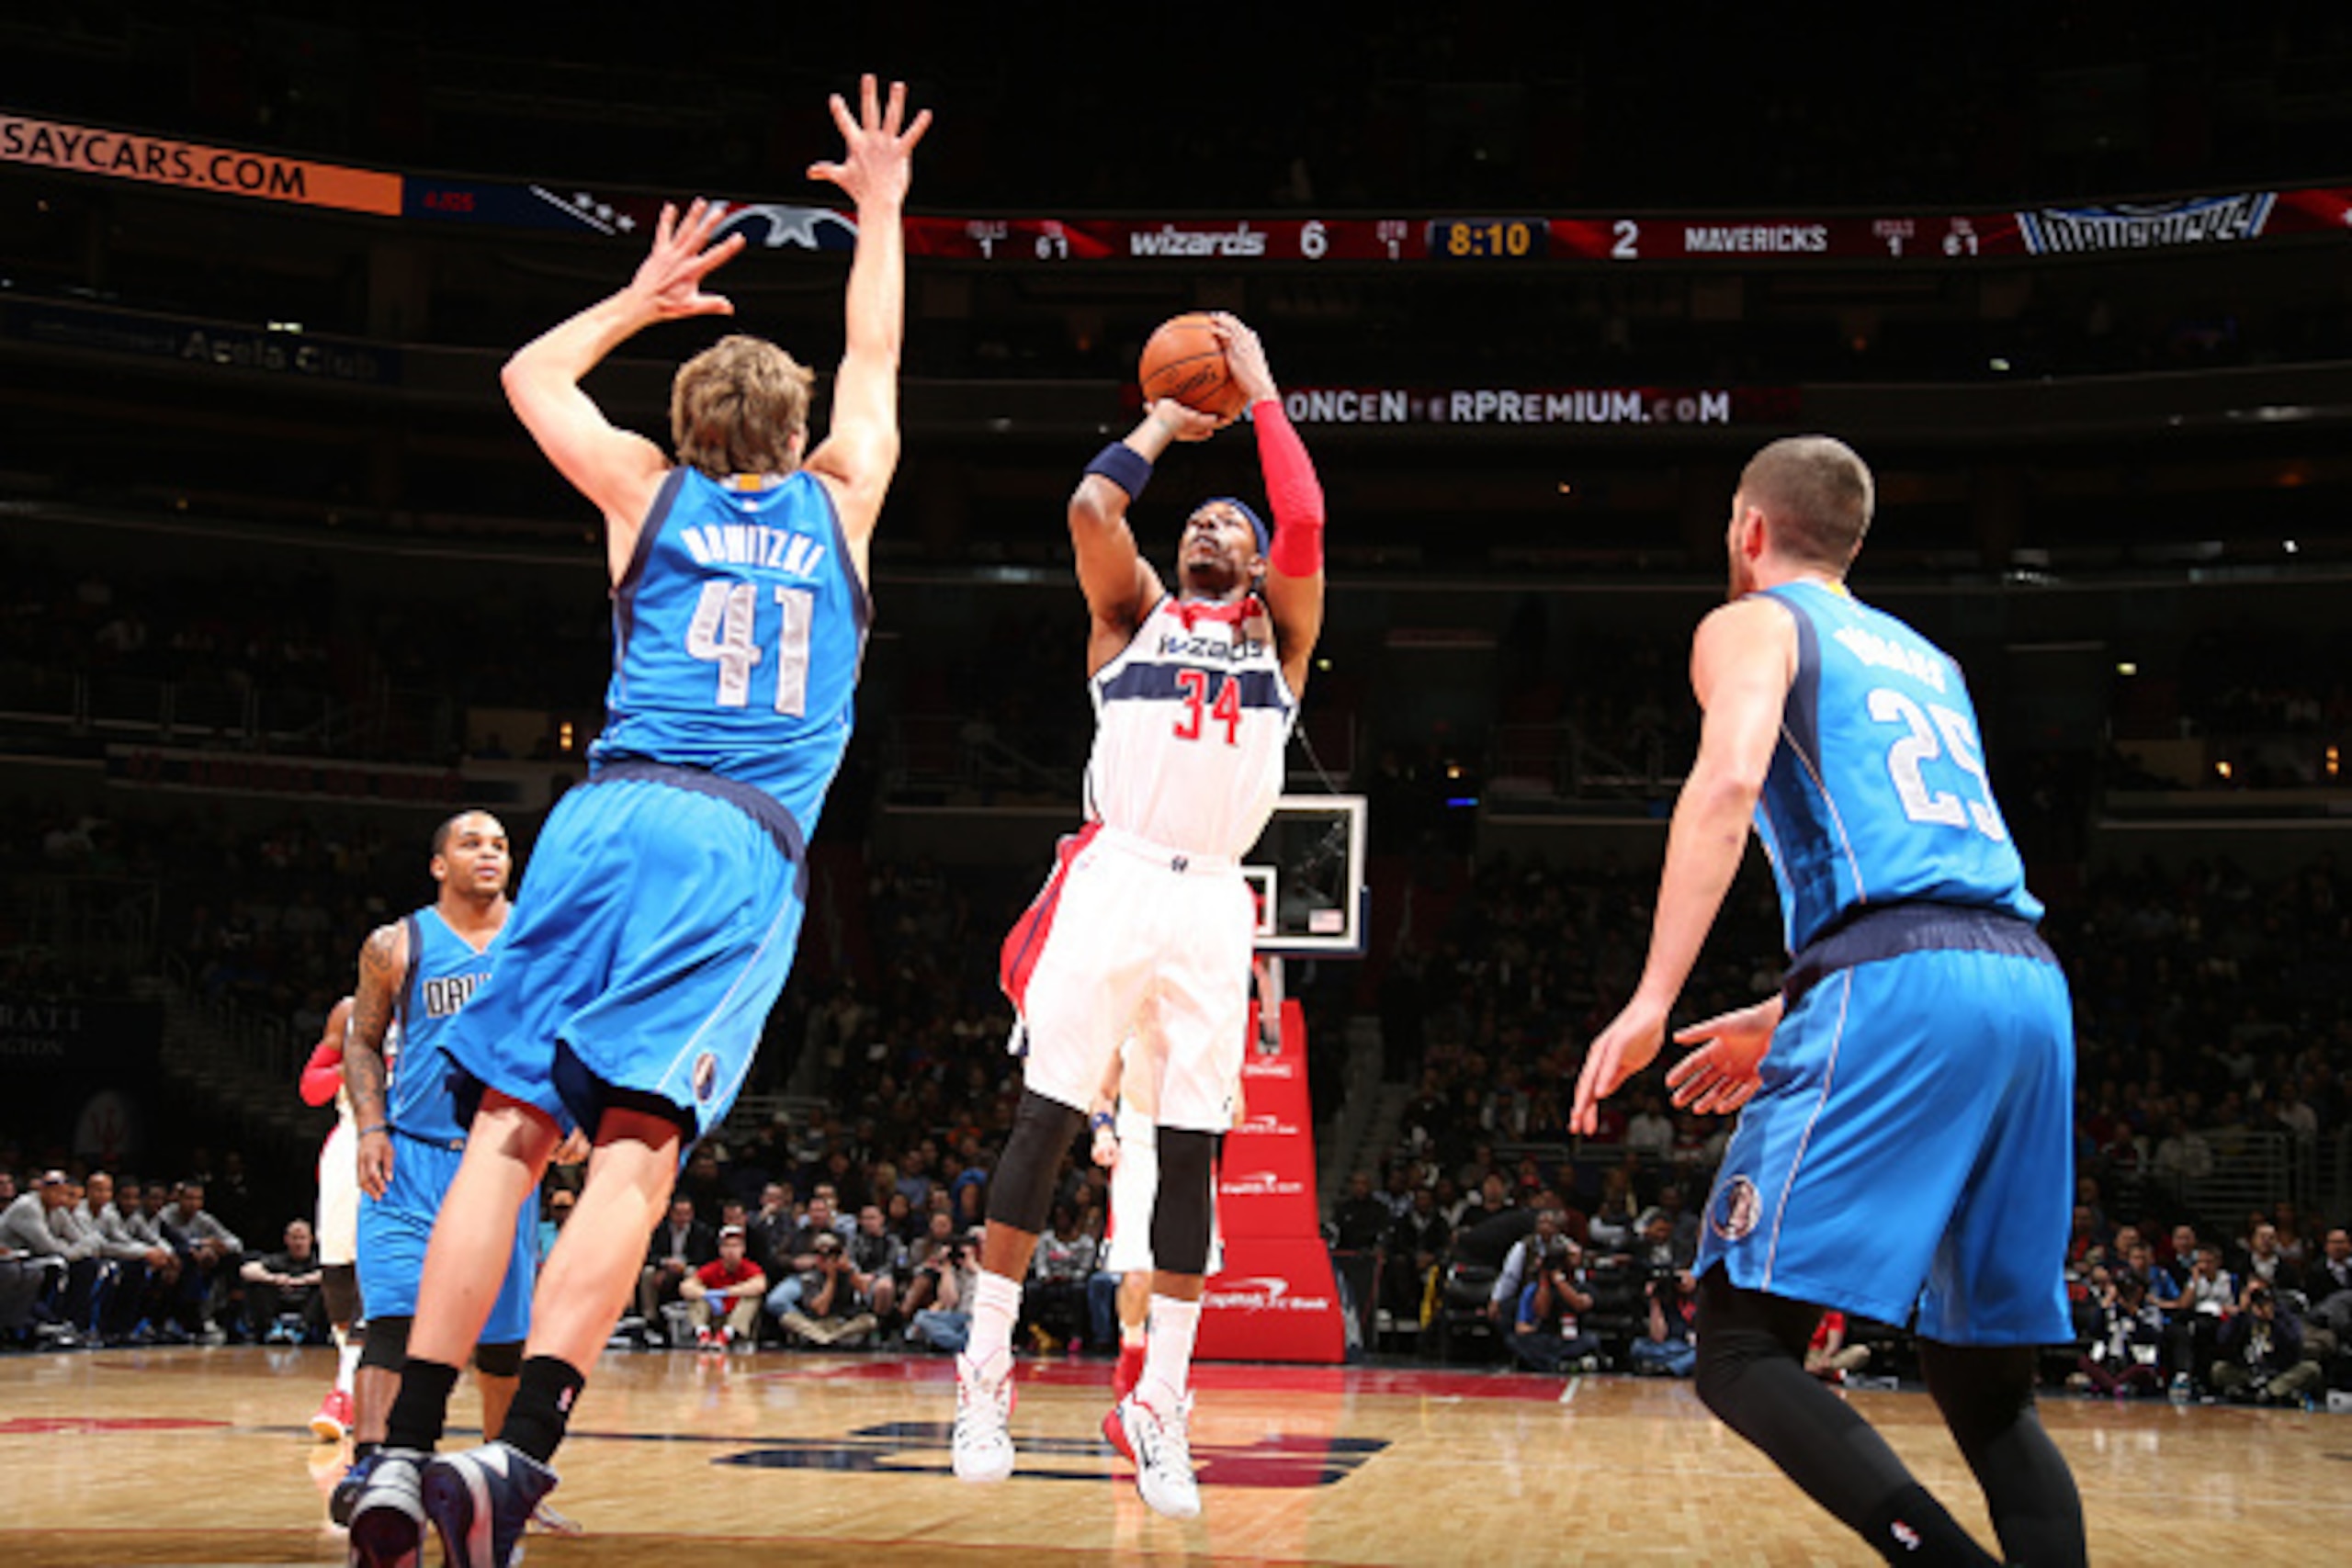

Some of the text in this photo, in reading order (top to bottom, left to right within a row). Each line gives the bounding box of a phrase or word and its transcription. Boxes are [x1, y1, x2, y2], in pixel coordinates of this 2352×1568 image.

[3, 122, 306, 198] SAYCARS.COM
[1130, 220, 1269, 256] wizards
[1300, 220, 1329, 259] 6
[1447, 222, 1532, 256] 8:10
[1611, 220, 1639, 260] 2
[1684, 224, 1828, 253] MAVERICKS
[684, 580, 815, 718] 41
[1171, 670, 1242, 748] 34
[1866, 687, 2006, 843] 25
